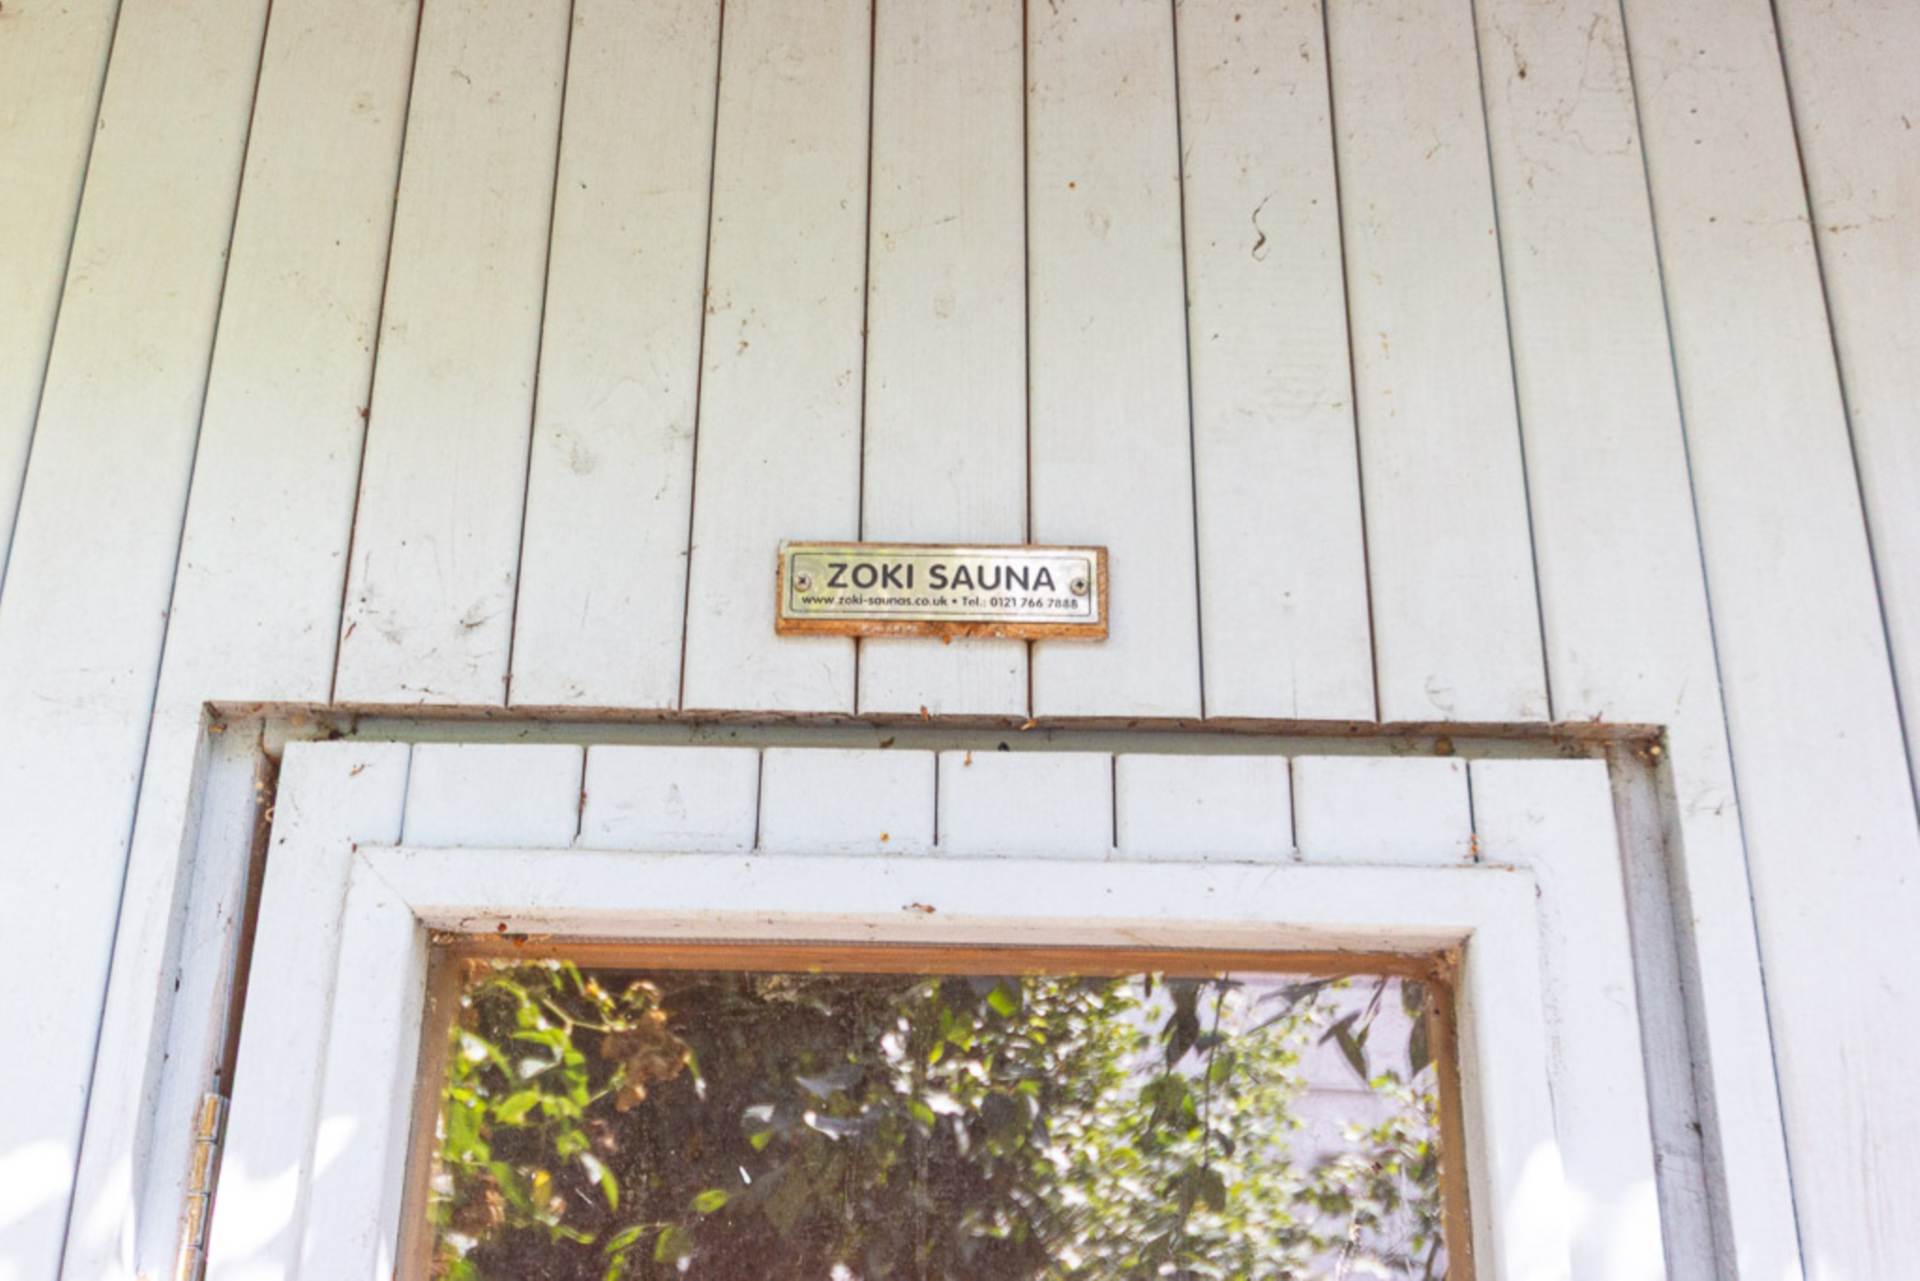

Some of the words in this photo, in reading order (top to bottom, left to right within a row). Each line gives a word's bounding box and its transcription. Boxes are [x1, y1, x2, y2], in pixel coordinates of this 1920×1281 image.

[826, 563, 913, 588] ZOKI
[928, 564, 1056, 591] SAUNA
[990, 597, 1016, 608] 0121
[1020, 597, 1044, 609] 766
